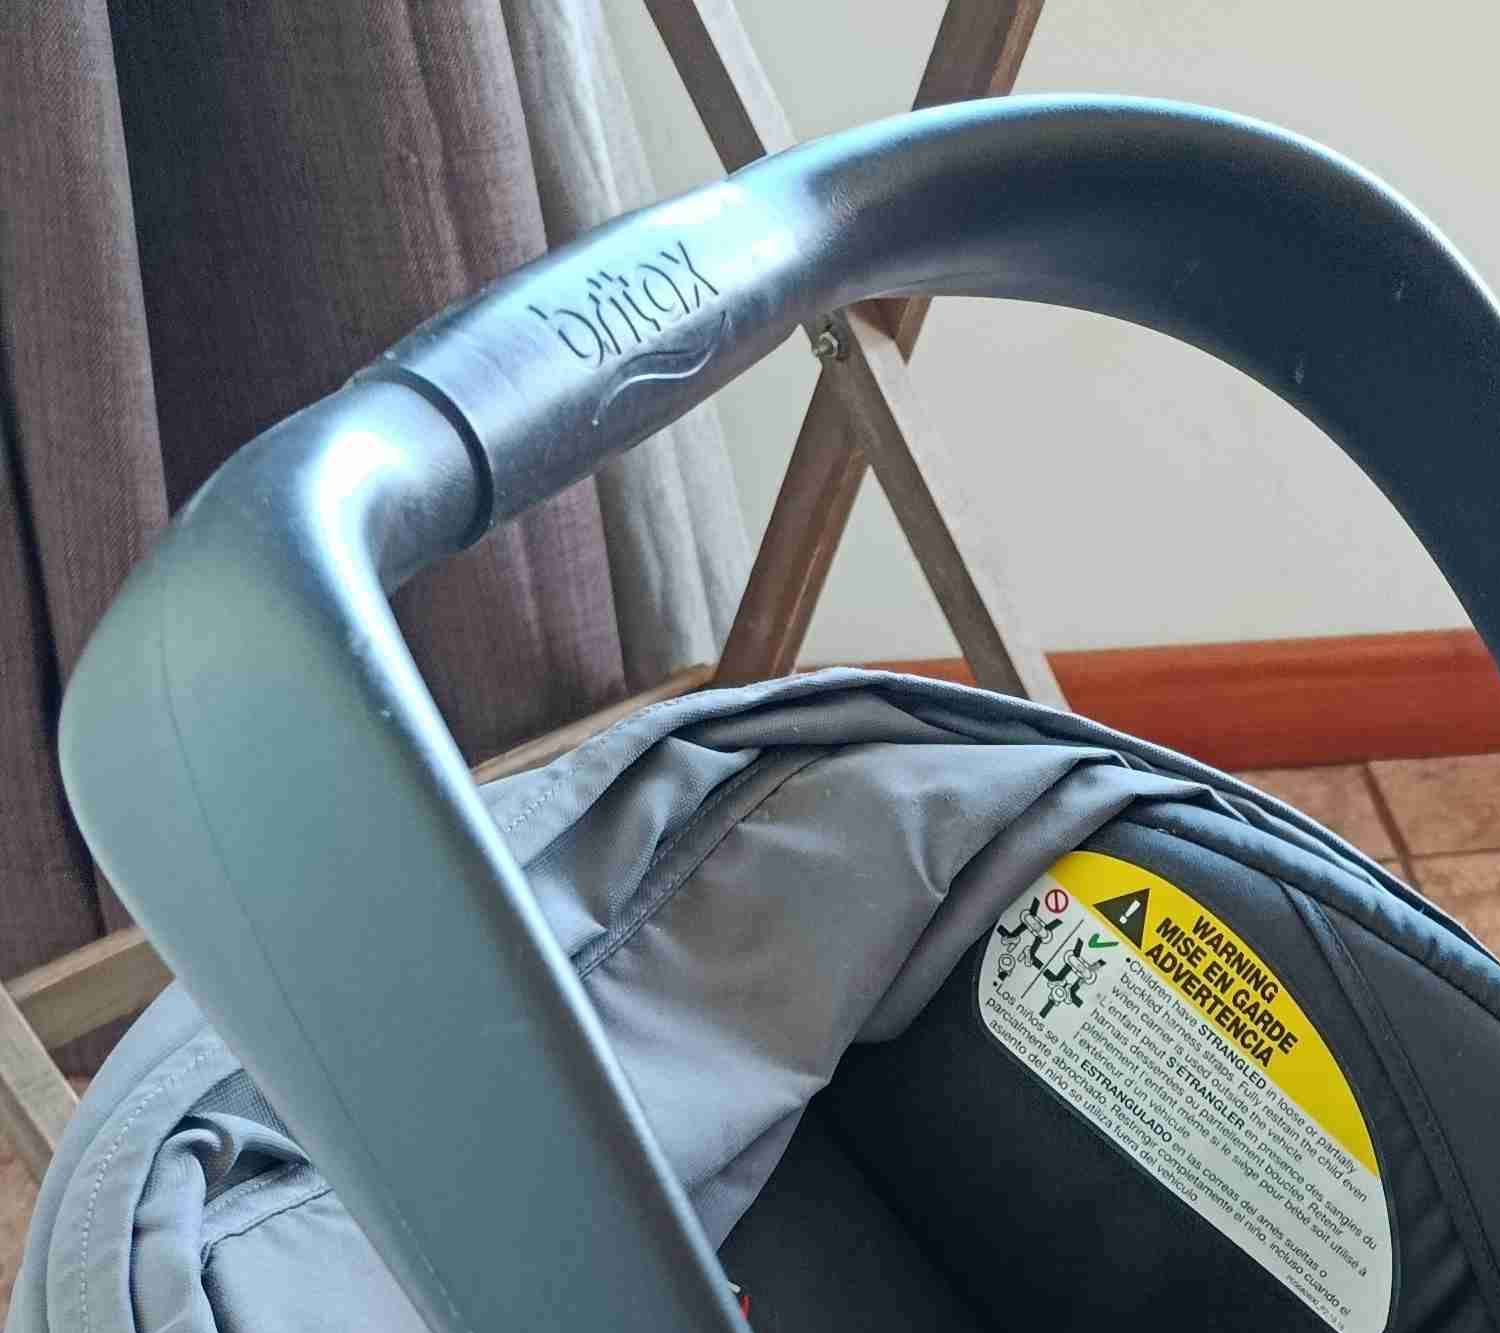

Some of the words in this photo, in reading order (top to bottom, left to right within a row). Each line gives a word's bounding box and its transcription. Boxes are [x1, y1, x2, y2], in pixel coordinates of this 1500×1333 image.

[1110, 984, 1141, 1015] when
[1139, 1012, 1175, 1045] carrier
[1184, 1052, 1213, 1080] used
[1210, 1077, 1250, 1115] outside
[1248, 1111, 1267, 1130] the
[1143, 942, 1276, 1068] ADVERTENCIA
[1155, 917, 1208, 969] MISE
[1202, 960, 1235, 995] EN
[1230, 987, 1300, 1055] GARDE
[1190, 915, 1280, 1005] WARNING
[984, 996, 1052, 1058] parcialmente
[1109, 1103, 1159, 1150] Restringir
[1156, 1147, 1234, 1215] completamente
[1269, 1241, 1304, 1275] incluso
[1302, 1272, 1340, 1308] cuando
[988, 1018, 1028, 1055] asiento
[1026, 1052, 1047, 1071] del
[1044, 1066, 1070, 1091] niño
[1082, 1099, 1114, 1129] utiliza
[1112, 1124, 1140, 1152] fuera
[1139, 1149, 1158, 1167] del
[994, 983, 1016, 1006] Los
[1015, 1002, 1046, 1032] niños
[1058, 1040, 1080, 1064] han
[1080, 1058, 1173, 1144] ESTRANGULADO
[1186, 1152, 1202, 1171] las
[1201, 1166, 1241, 1202] correas
[1239, 1199, 1259, 1216] del
[1284, 1238, 1320, 1271] sueltas
[1080, 1020, 1140, 1075] pleinement
[1257, 1178, 1285, 1202] pour
[1283, 1198, 1312, 1226] bébé
[1310, 1223, 1331, 1244] soit
[1089, 1007, 1130, 1047] harnais
[1197, 1107, 1266, 1168] partiellement
[1306, 1201, 1344, 1236] Retenir
[1118, 971, 1164, 1015] buckled
[1160, 1010, 1204, 1053] harness
[1236, 1080, 1264, 1107] Fully
[1261, 1104, 1301, 1142] restrain
[1299, 1137, 1318, 1158] the
[1316, 1154, 1345, 1180] child
[1342, 1178, 1368, 1203] even
[1128, 959, 1174, 1004] Children
[1170, 999, 1198, 1028] have
[1196, 1023, 1268, 1090] STRANGLED
[1276, 1097, 1306, 1128] loose
[1315, 1136, 1358, 1175] partially
[1139, 1034, 1167, 1060] peut
[1304, 1182, 1325, 1203] des
[1323, 1200, 1364, 1238] sangles
